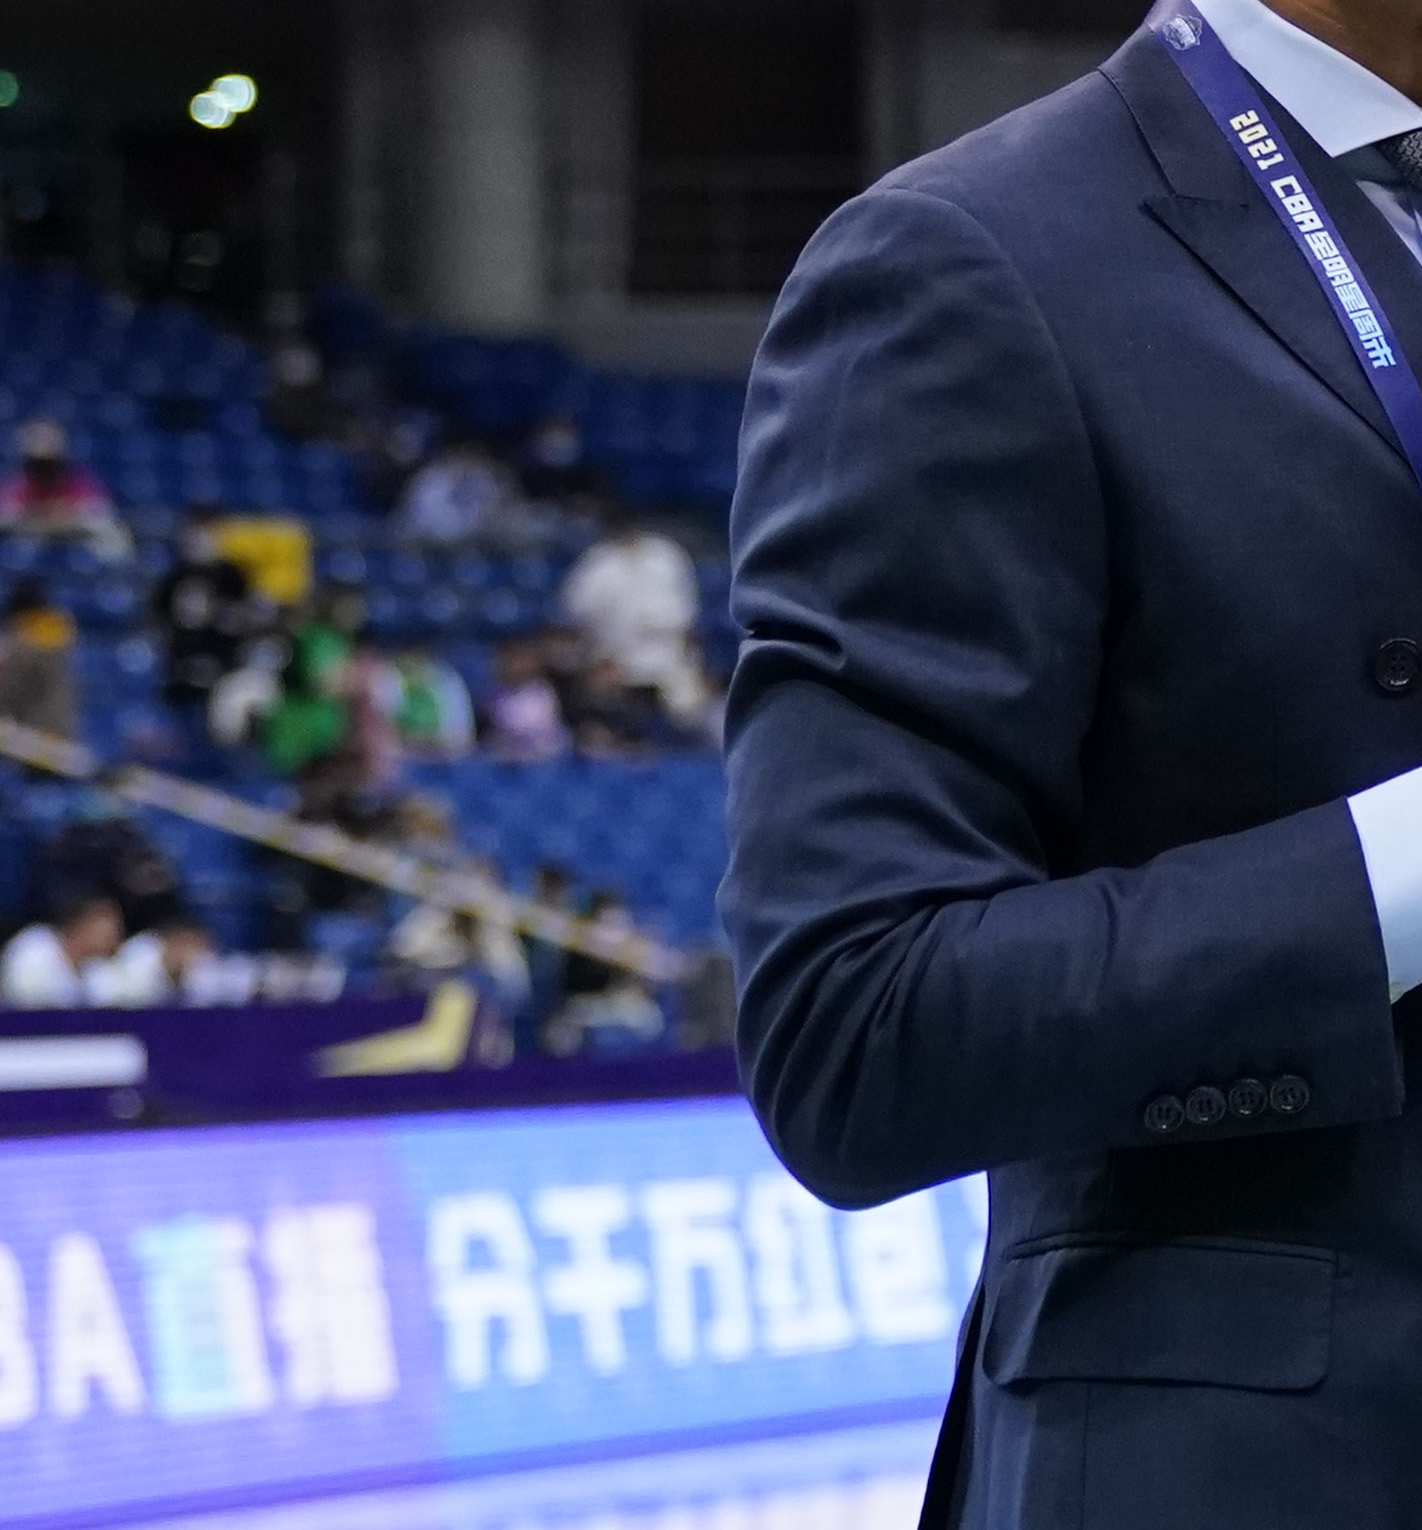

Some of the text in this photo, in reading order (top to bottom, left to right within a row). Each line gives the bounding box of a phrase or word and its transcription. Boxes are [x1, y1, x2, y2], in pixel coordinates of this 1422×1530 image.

[1229, 110, 1397, 368] 2021 CBA全明星周末
